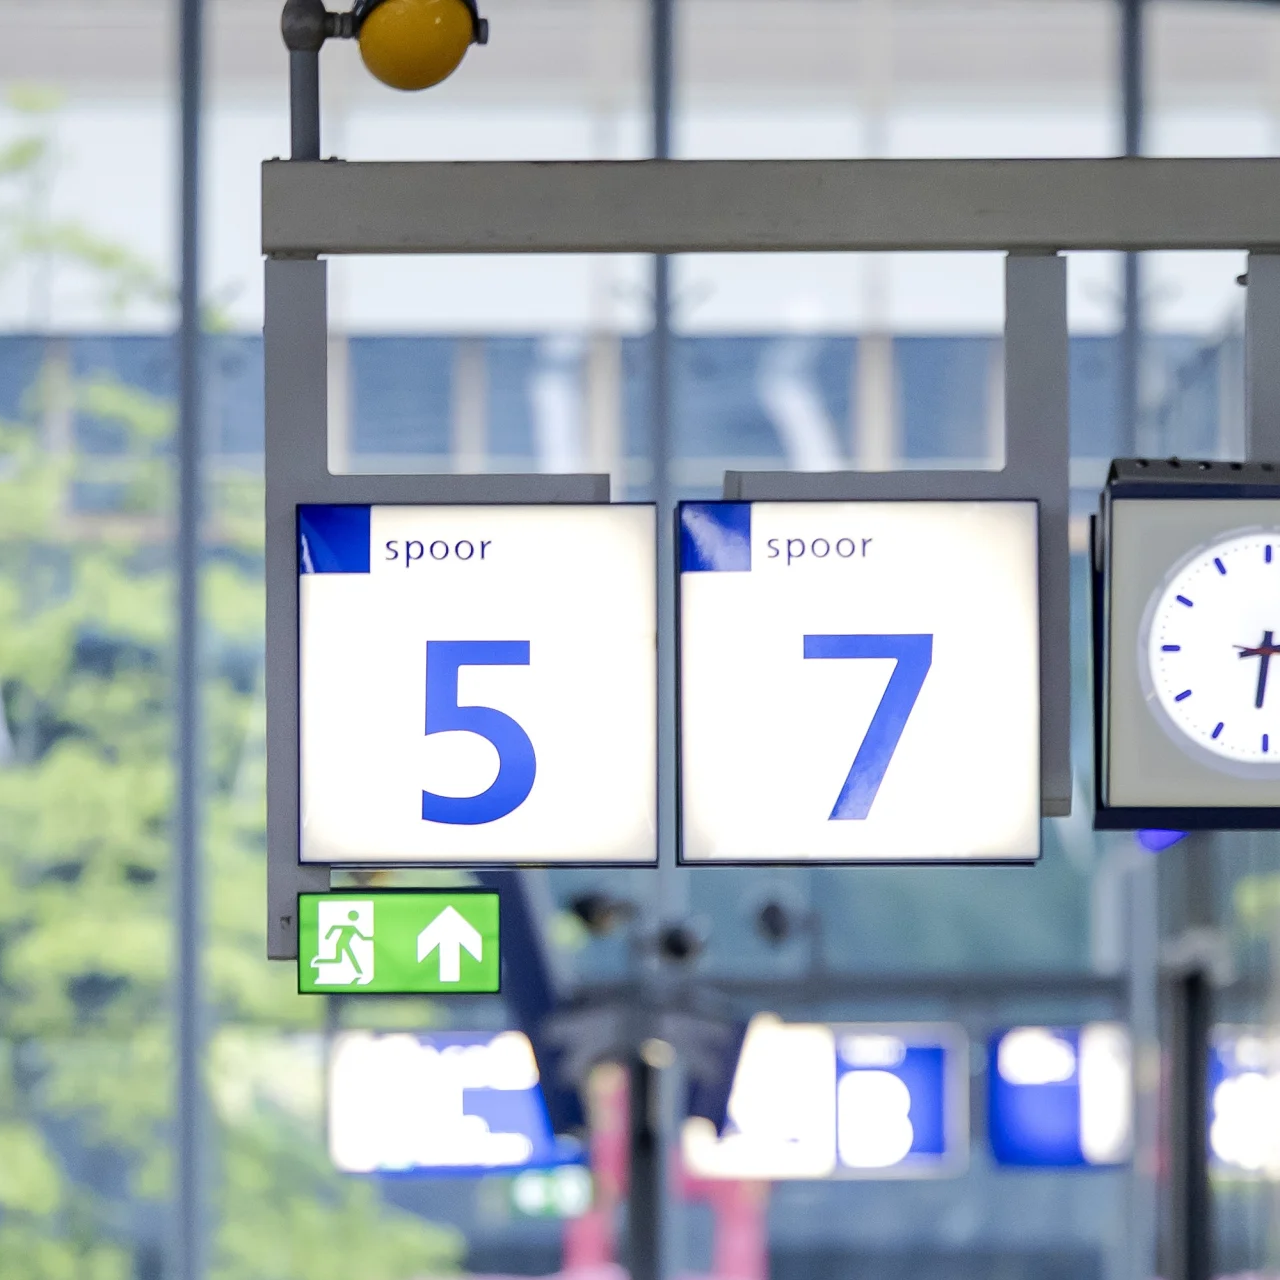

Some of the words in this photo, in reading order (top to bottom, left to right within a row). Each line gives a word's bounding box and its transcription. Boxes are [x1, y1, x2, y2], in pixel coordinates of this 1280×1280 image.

[385, 538, 493, 569] spoor
[766, 536, 873, 566] spoor
[421, 639, 537, 826] 5
[802, 633, 934, 821] 7
